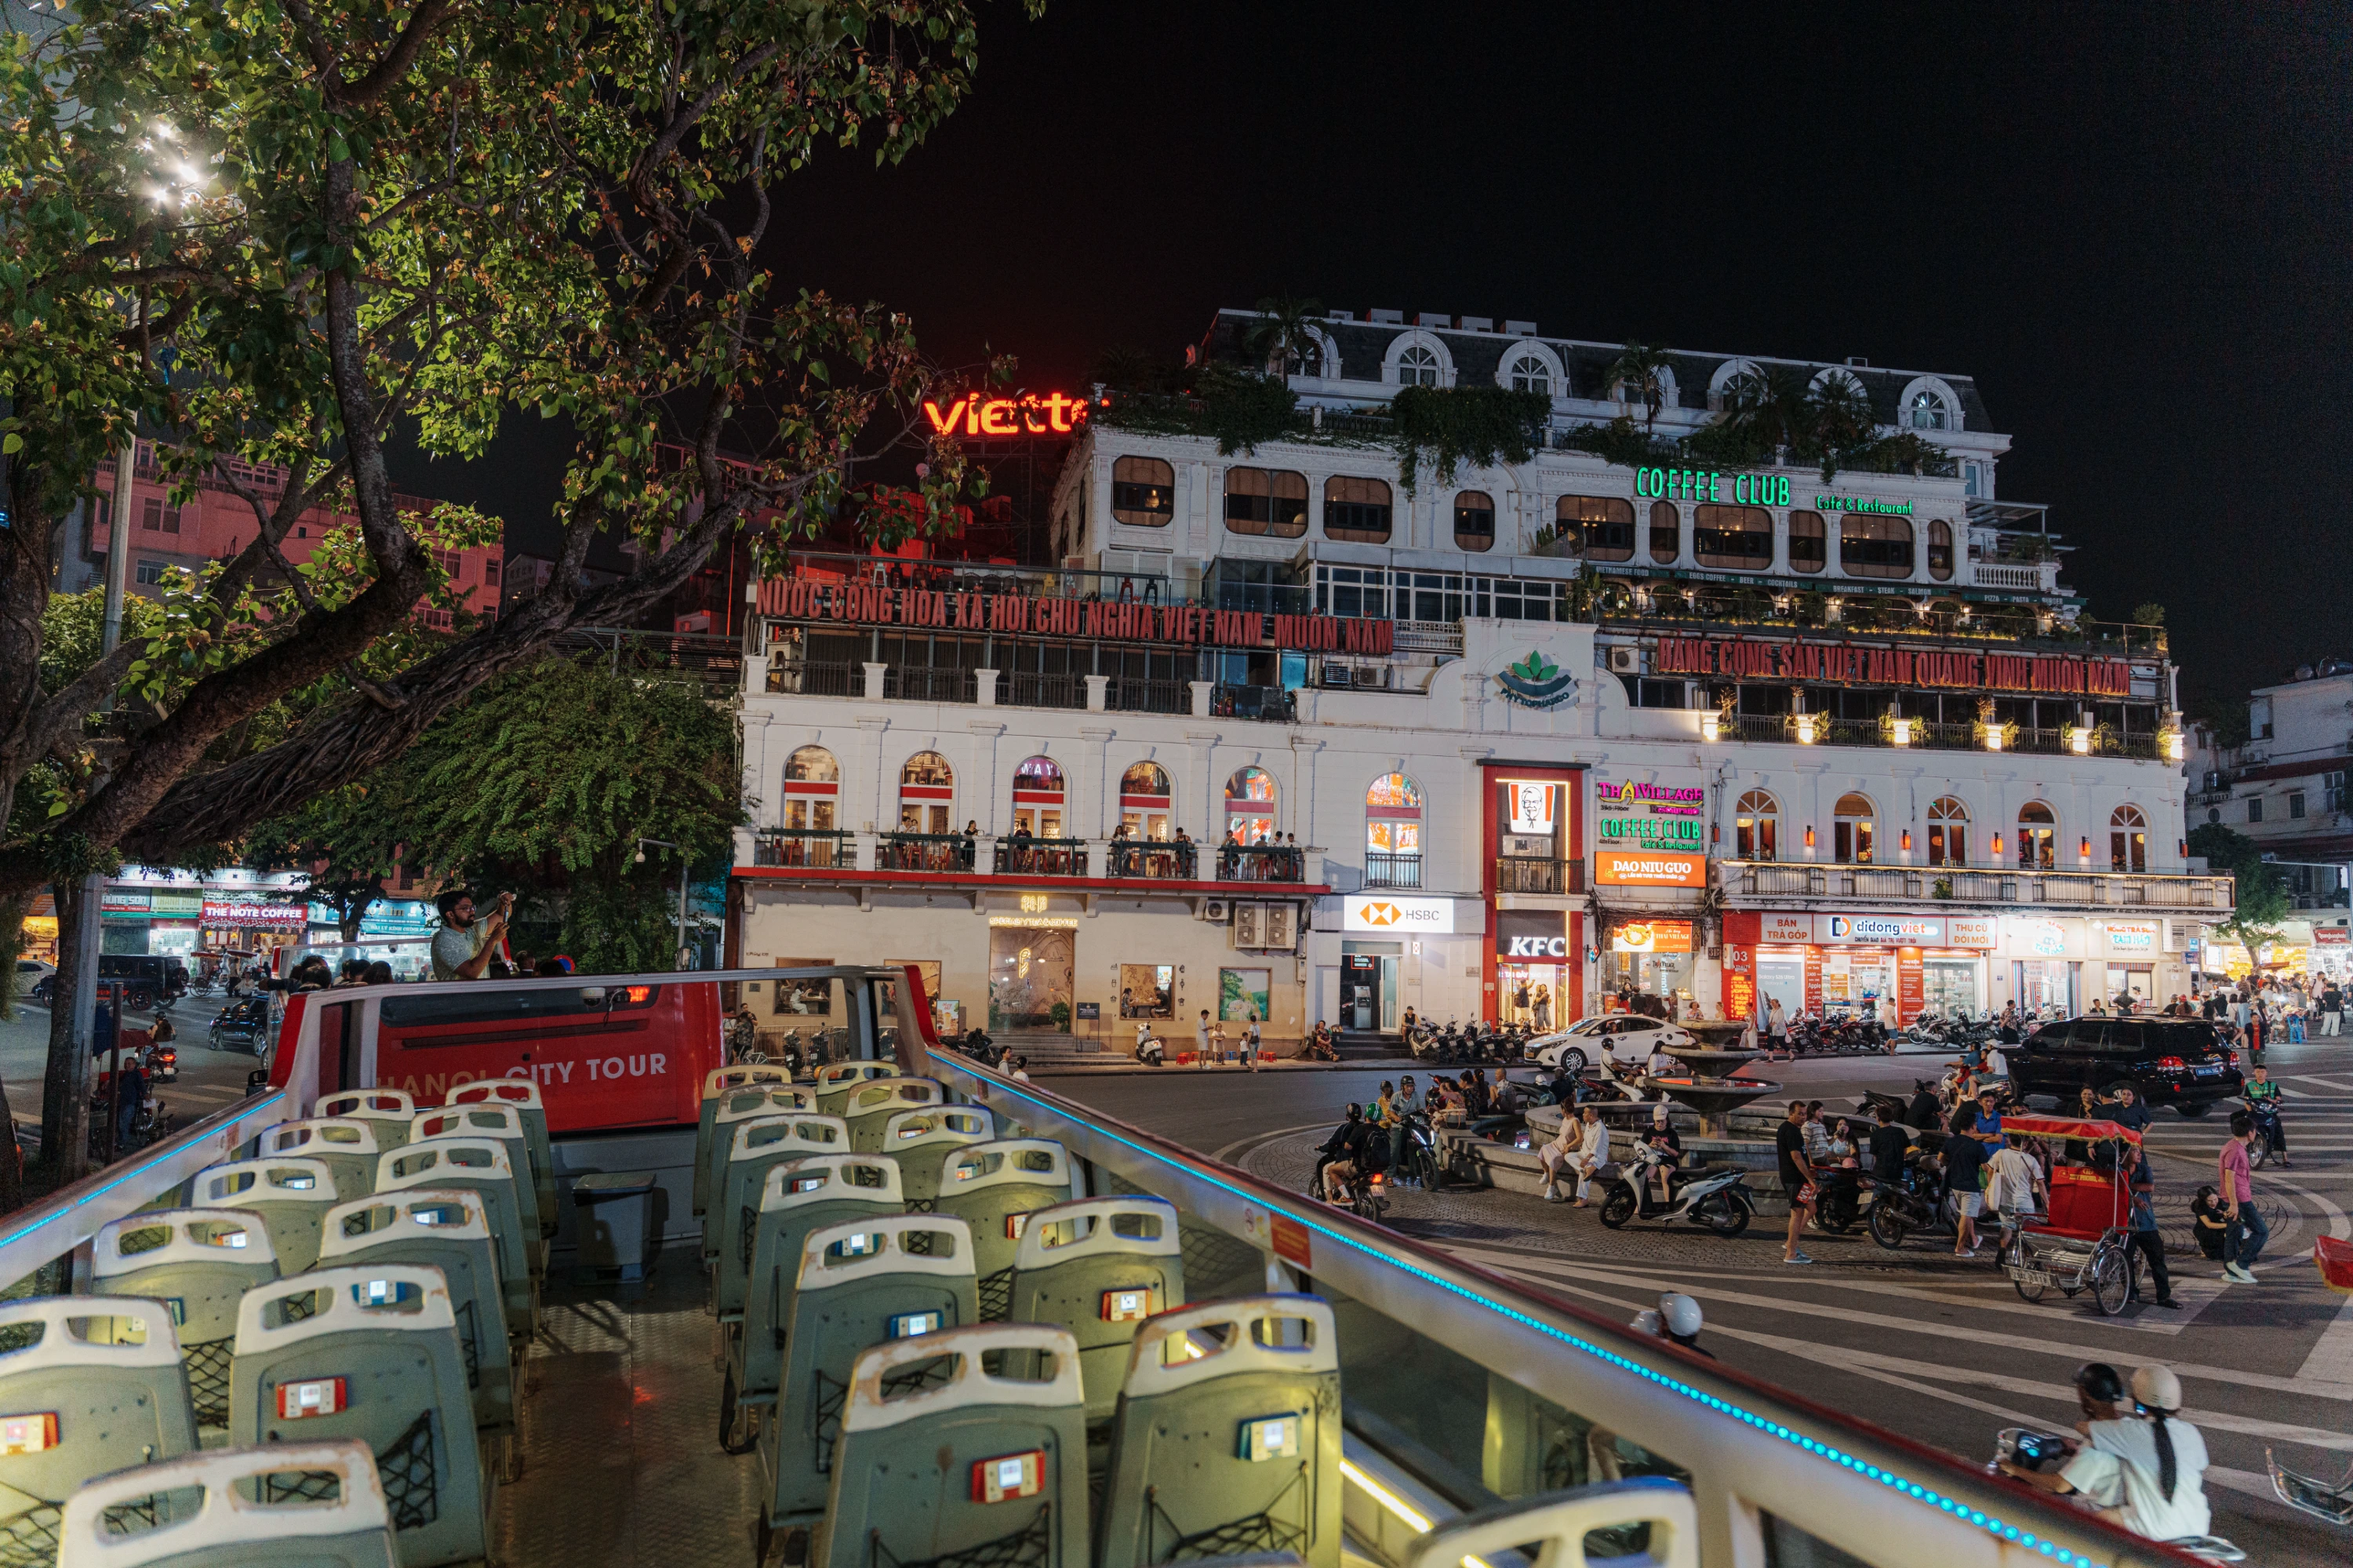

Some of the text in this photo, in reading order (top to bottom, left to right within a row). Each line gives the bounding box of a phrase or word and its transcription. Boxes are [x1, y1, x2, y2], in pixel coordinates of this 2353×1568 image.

[1637, 467, 1791, 507] COFFEE CLUB
[1817, 495, 1913, 515] Café & Restaurant
[1634, 568, 1649, 577] FOOD
[1689, 572, 1704, 580] EGGS
[1705, 573, 1726, 582] COFFEE
[1767, 579, 1798, 588] COCKTAILS
[755, 575, 823, 619] NƯỚC
[831, 577, 893, 627] CỘNG
[954, 585, 984, 629] XÃ
[991, 587, 1028, 638] HỘI
[1035, 588, 1079, 635] CHỦ
[1087, 596, 1155, 640] NGHĨA
[1164, 598, 1209, 649] VIỆT
[1213, 609, 1263, 647] NAM
[1275, 607, 1337, 650] MUÔN
[1345, 610, 1393, 654] NĂM
[1657, 628, 2130, 696] ĐẢNG CỘNG SẢN VIỆT NAM QUANG VINH MUÔN NĂM
[1638, 783, 1703, 800] VILLAGE
[1601, 818, 1701, 839] COFFEE CLUB
[1665, 840, 1701, 850] Restaurant
[1613, 860, 1692, 874] DAO NIU GUO
[205, 908, 302, 918] THE NOTE COFFEE
[1406, 910, 1440, 921] HSBC
[1777, 917, 1797, 927] BÁN
[1857, 921, 1926, 935] didongviet
[1955, 922, 1988, 932] THU CŨ
[1767, 928, 1808, 940] TRÀ GÓP
[1508, 936, 1566, 957] KFC
[1733, 951, 1748, 962] 03
[505, 1060, 575, 1086] CITY
[587, 1053, 667, 1081] TOUR
